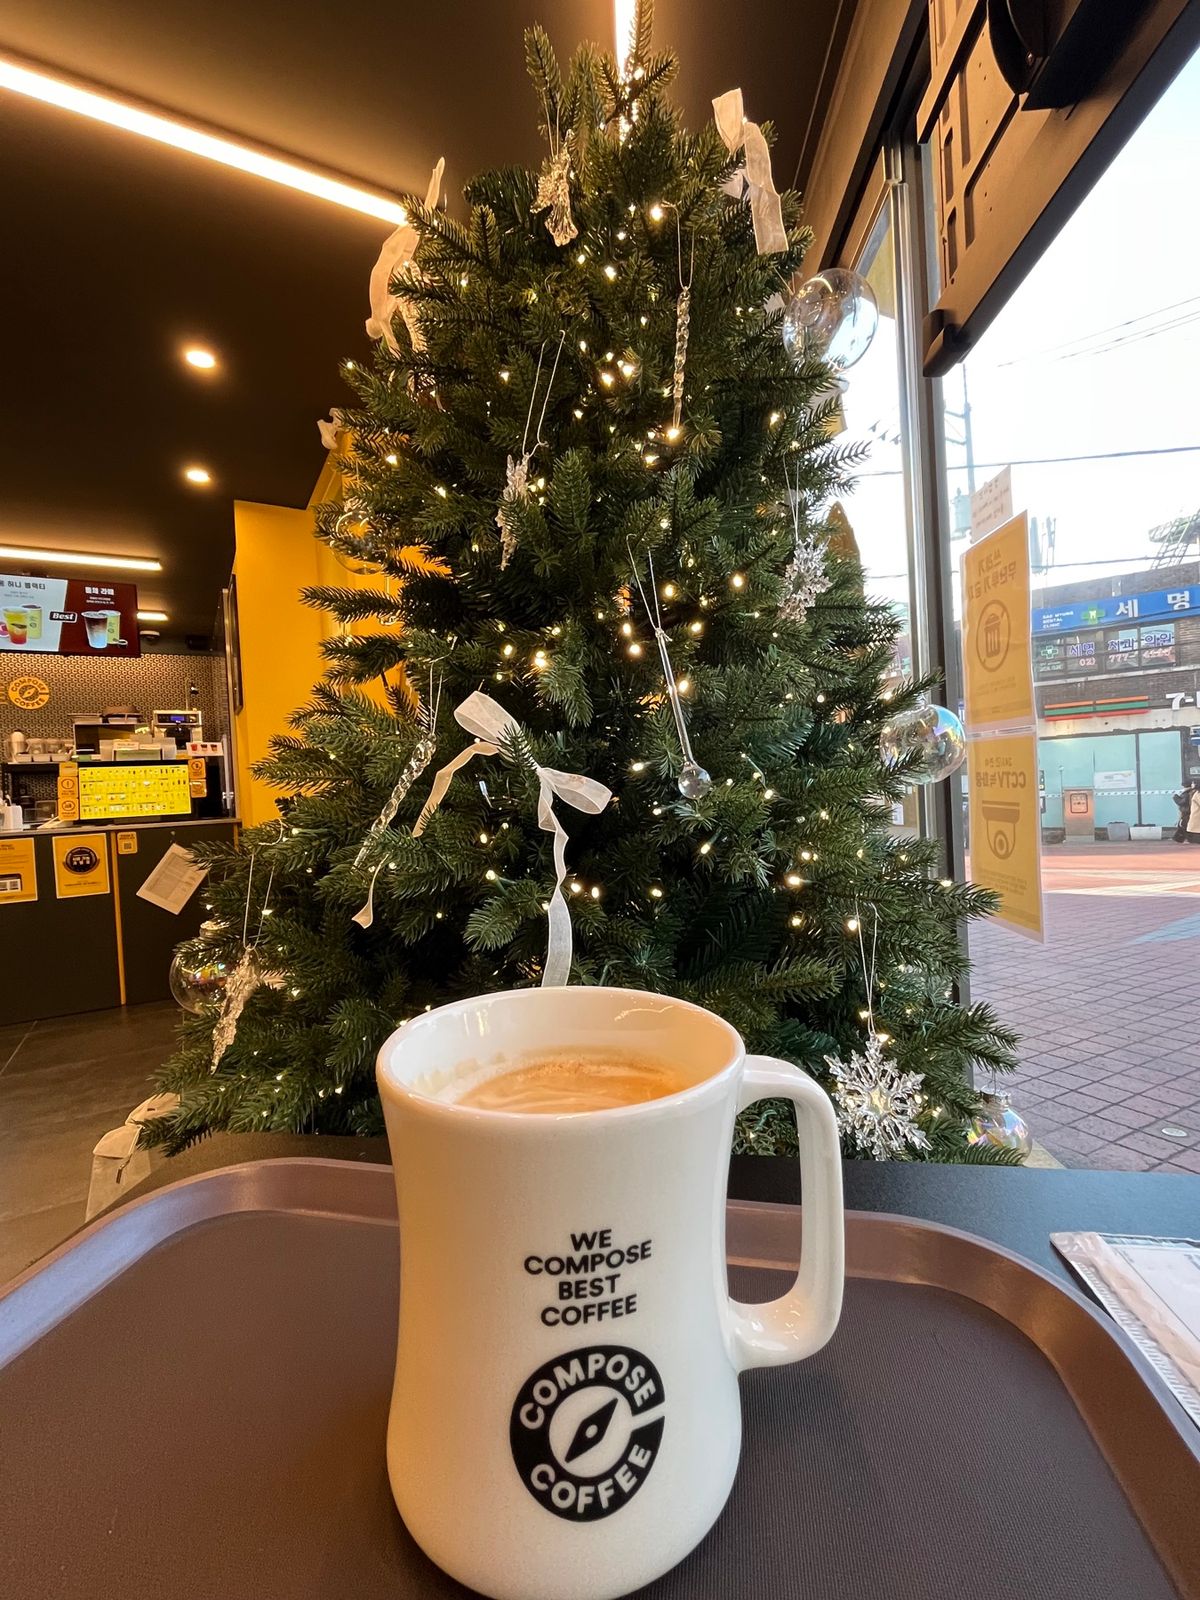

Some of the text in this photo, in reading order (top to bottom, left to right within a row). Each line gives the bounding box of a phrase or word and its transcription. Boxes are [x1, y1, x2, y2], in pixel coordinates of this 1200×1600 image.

[53, 612, 74, 620] Best
[570, 1229, 612, 1251] WE
[523, 1240, 652, 1276] COMPOSE
[558, 1274, 621, 1301] BEST
[540, 1294, 638, 1327] COFFEE
[519, 1353, 657, 1430] COMPOSE
[530, 1444, 652, 1514] COFFEE
